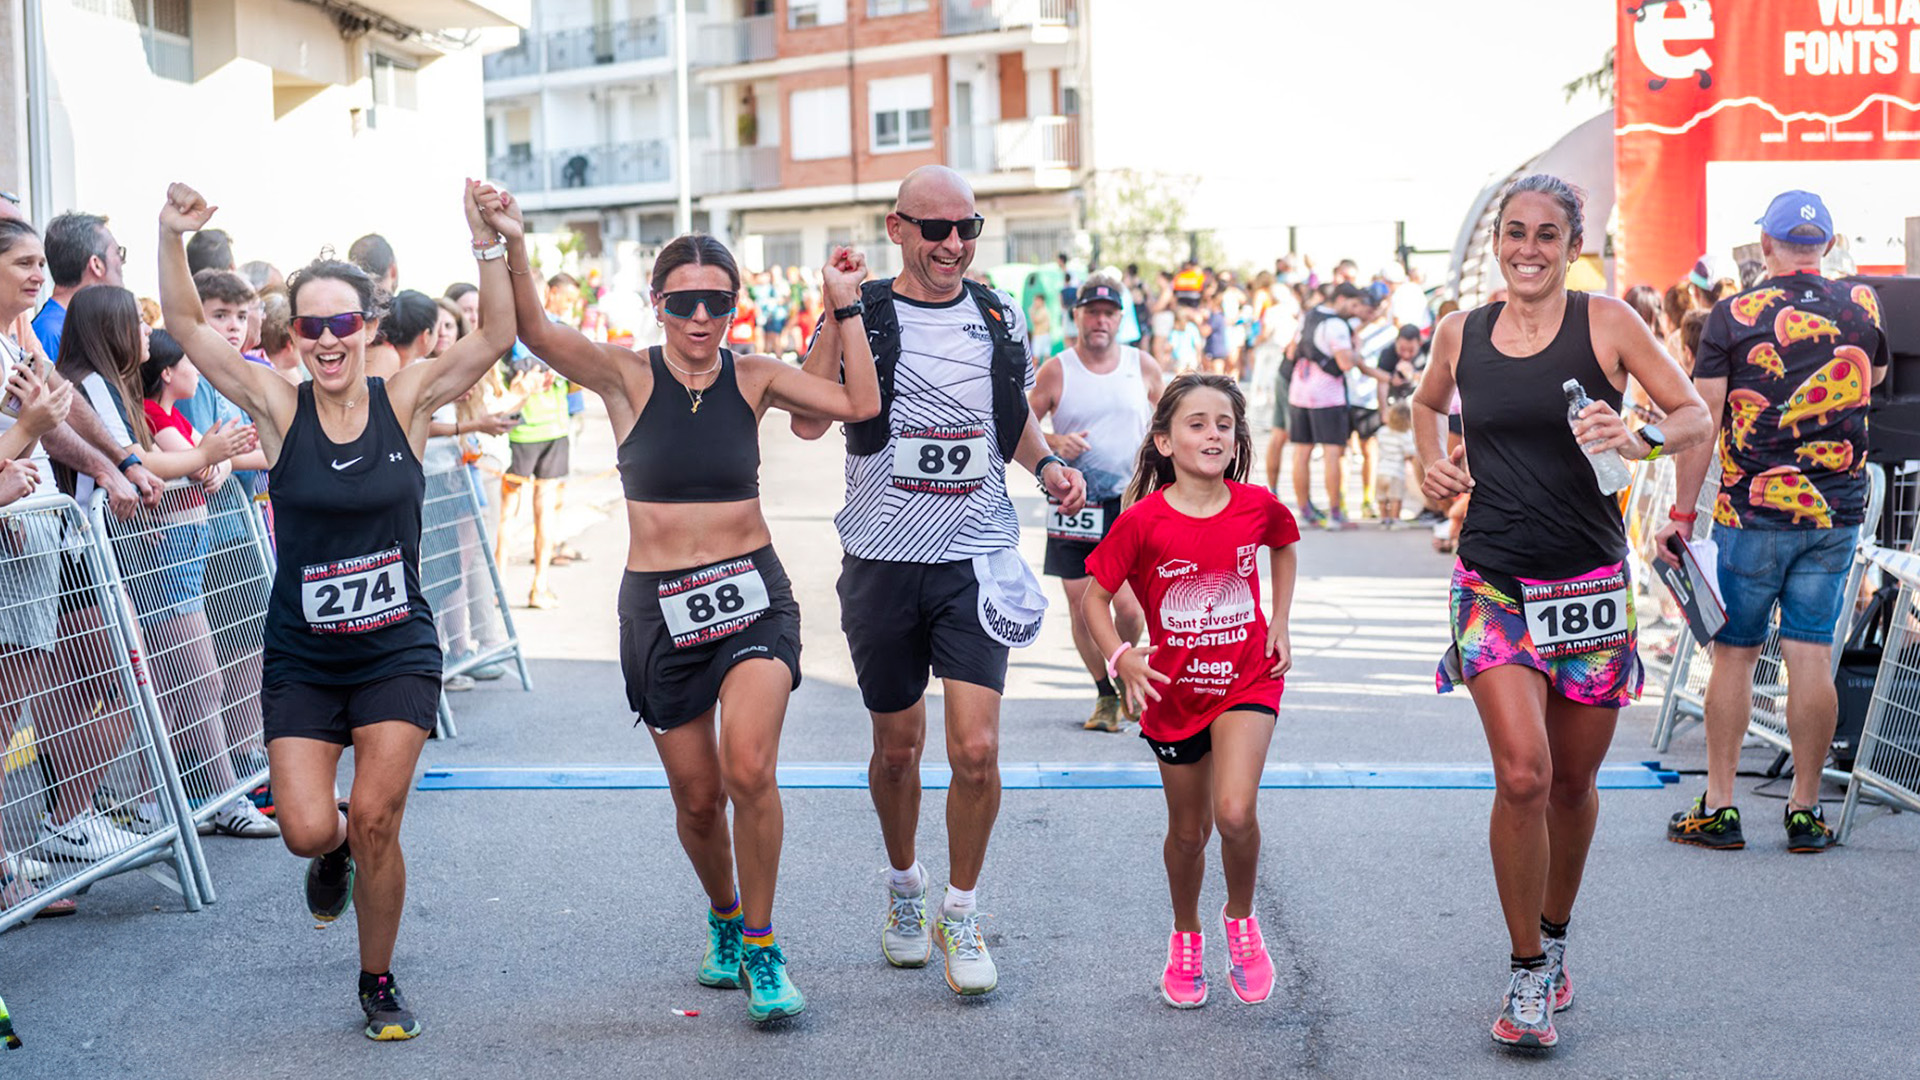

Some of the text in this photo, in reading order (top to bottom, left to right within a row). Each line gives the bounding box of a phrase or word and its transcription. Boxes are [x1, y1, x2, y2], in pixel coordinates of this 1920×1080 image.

[1784, 30, 1899, 76] FONTS
[918, 444, 971, 475] 89
[1054, 511, 1095, 530] 135
[691, 559, 754, 587] ADDICTION
[1156, 563, 1198, 579] Runner's
[315, 571, 395, 617] 274
[686, 583, 745, 624] 88
[1525, 585, 1553, 602] RUN
[709, 611, 764, 639] ADDICTIO
[1167, 616, 1197, 630] Sant
[1537, 598, 1617, 637] 180
[1167, 635, 1185, 647] de
[1565, 632, 1627, 655] ADDICTION
[732, 645, 768, 660] HEAD
[1186, 658, 1234, 678] Jeep
[1176, 673, 1239, 686] AVENGE
